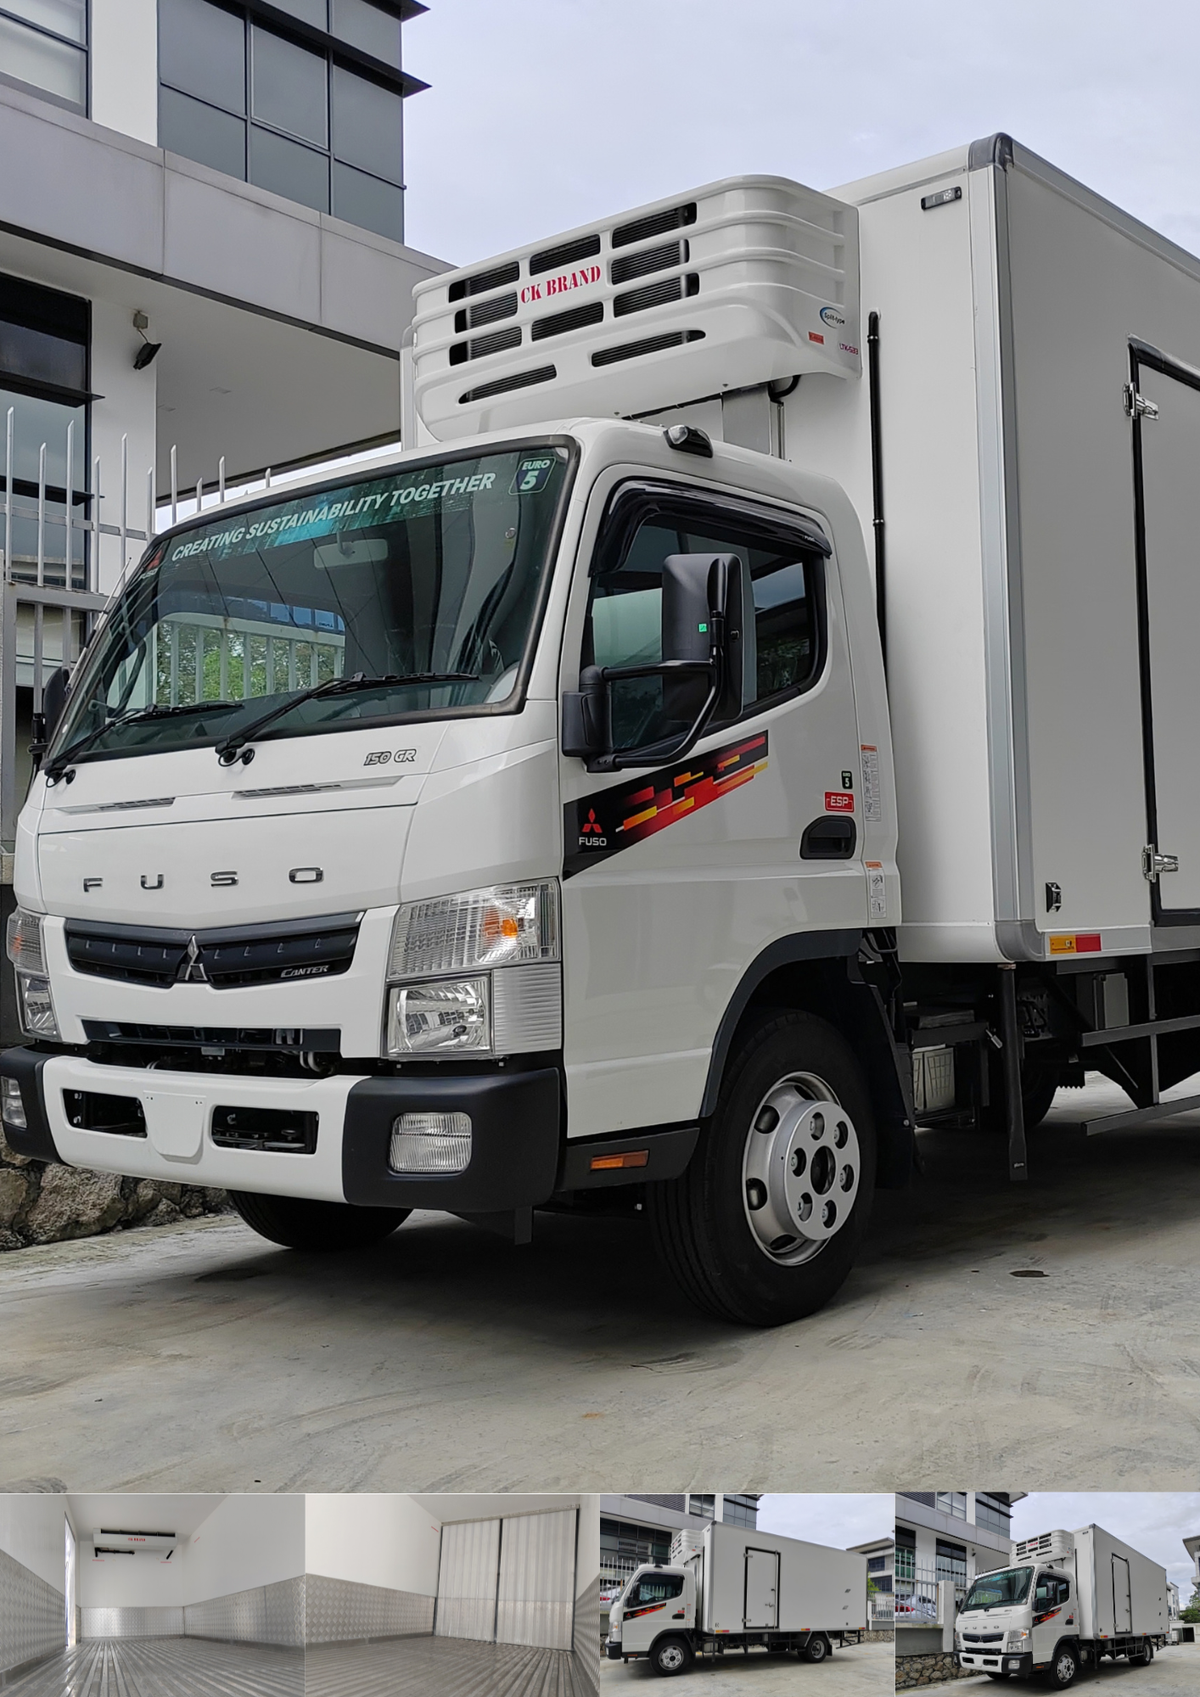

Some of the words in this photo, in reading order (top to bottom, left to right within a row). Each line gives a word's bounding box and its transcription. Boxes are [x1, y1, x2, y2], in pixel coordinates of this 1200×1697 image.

[520, 283, 542, 304] CK
[546, 265, 601, 296] BRAND
[521, 460, 551, 471] EURO
[519, 470, 539, 490] 5
[171, 527, 246, 562] CREATING
[245, 491, 390, 540] SUSTAINABILITY
[390, 472, 497, 506] TOGETHER
[363, 750, 392, 766] 150
[393, 748, 417, 763] GR
[844, 777, 850, 788] 5
[830, 795, 849, 807] ESP
[578, 836, 607, 846] FUSO
[83, 866, 324, 893] FUSO
[280, 964, 330, 979] CANTER
